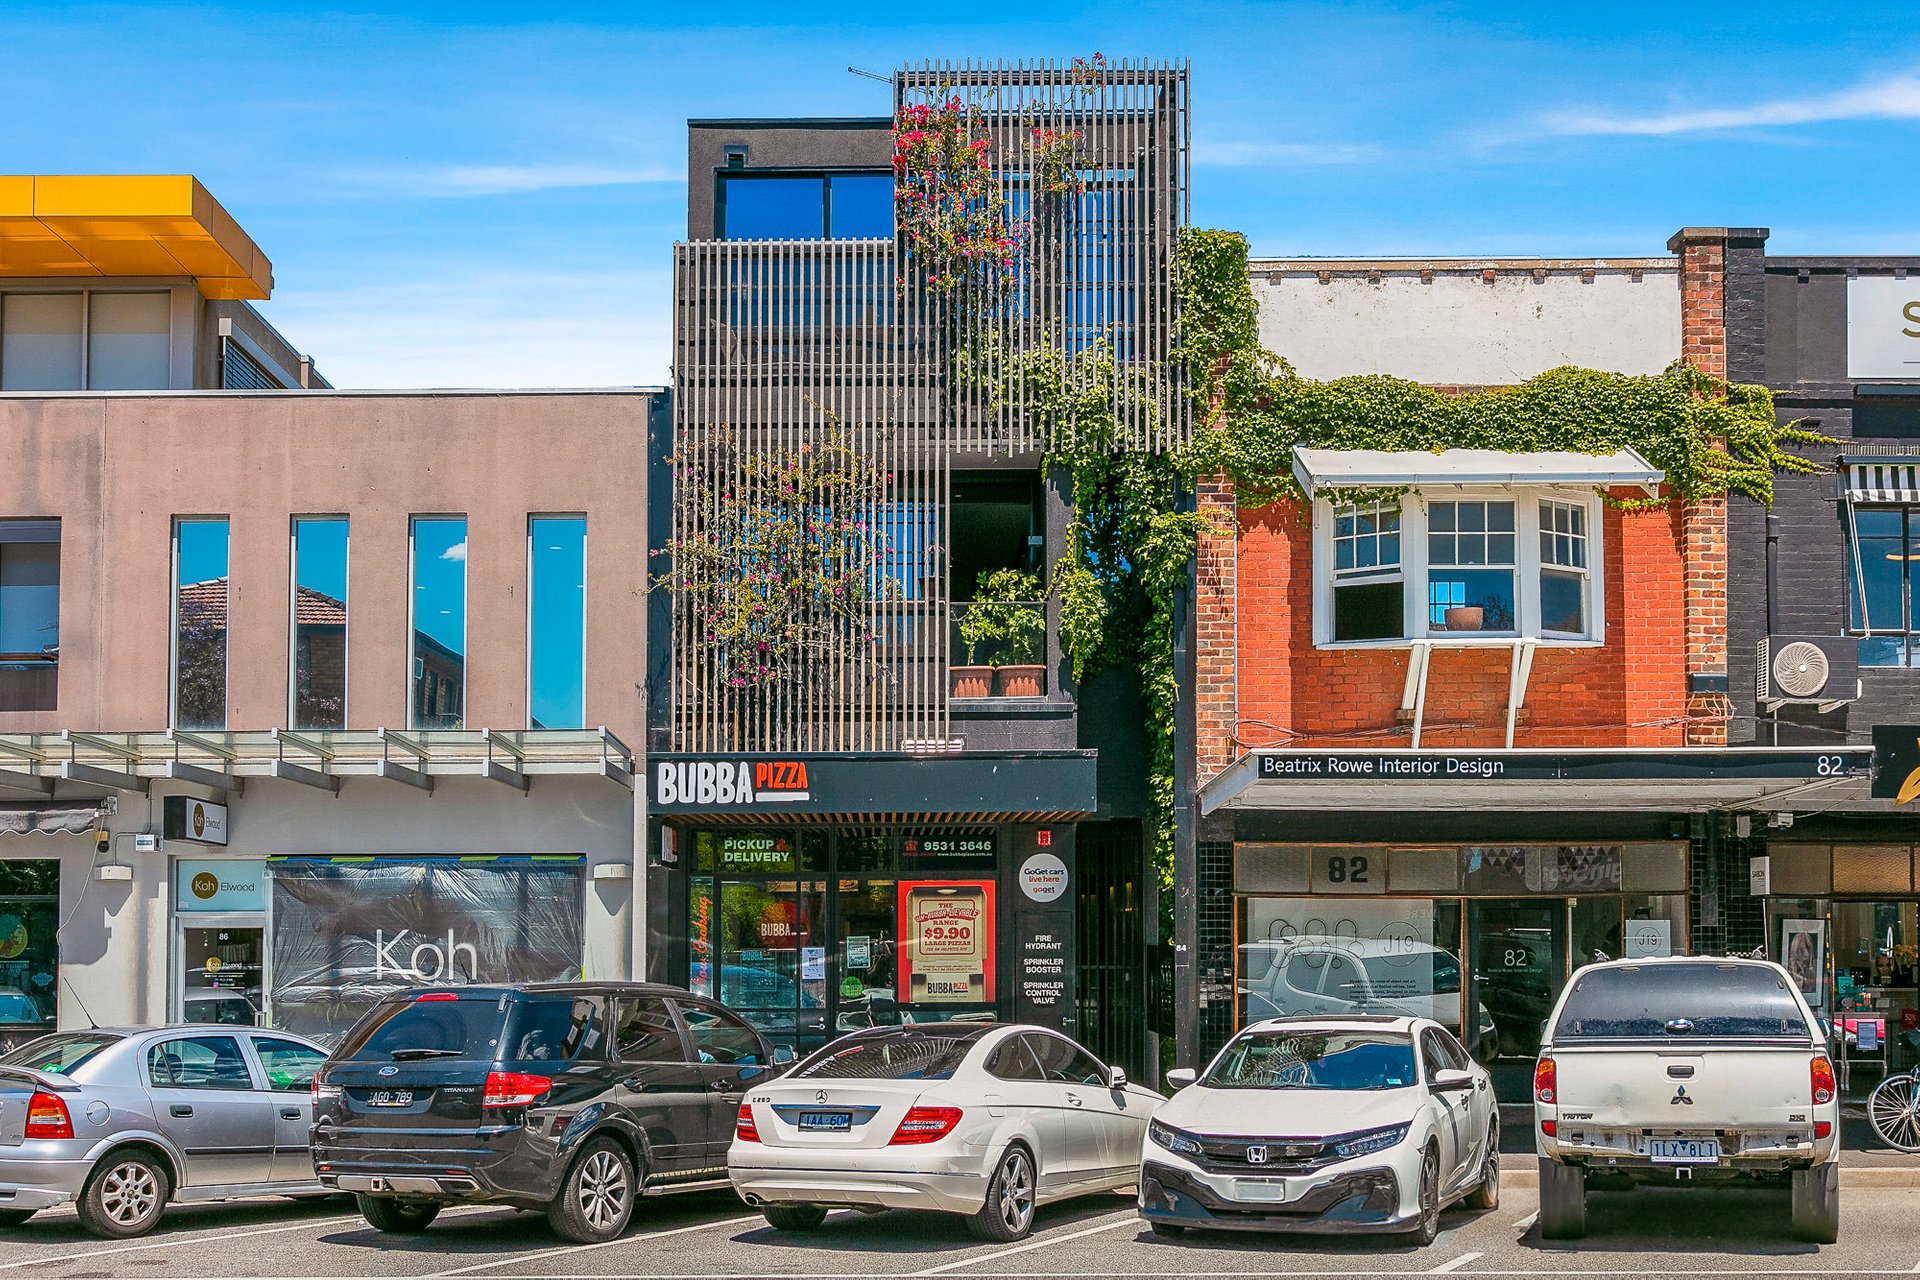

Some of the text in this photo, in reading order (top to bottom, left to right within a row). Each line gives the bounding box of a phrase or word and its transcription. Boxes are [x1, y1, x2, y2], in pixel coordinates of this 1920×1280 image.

[1264, 757, 1504, 777] Beatrix Rowe Interior Design
[1817, 755, 1844, 775] 82
[657, 761, 808, 804] BUBBA PIZZA
[194, 813, 204, 825] Koh
[206, 817, 221, 830] Elwood
[724, 840, 774, 850] PICKUP
[924, 841, 991, 851] 9531 3646
[724, 852, 789, 862] DELIVERY
[1328, 856, 1368, 883] 82
[194, 880, 215, 892] Koh
[220, 882, 255, 892] Elwood
[692, 896, 713, 954] Cooking
[761, 923, 791, 937] BUBBA
[218, 932, 229, 941] 86
[924, 927, 971, 940] $9.90
[1384, 934, 1414, 953] J19
[1638, 935, 1658, 946] J19
[376, 928, 478, 980] Koh
[1176, 944, 1187, 952] 84
[741, 951, 763, 961] BUBBA
[1504, 949, 1527, 966] 82
[927, 982, 968, 994] BUBBA PIZZA
[1562, 1112, 1593, 1120] TRITON
[1655, 1143, 1679, 1157] 1LX
